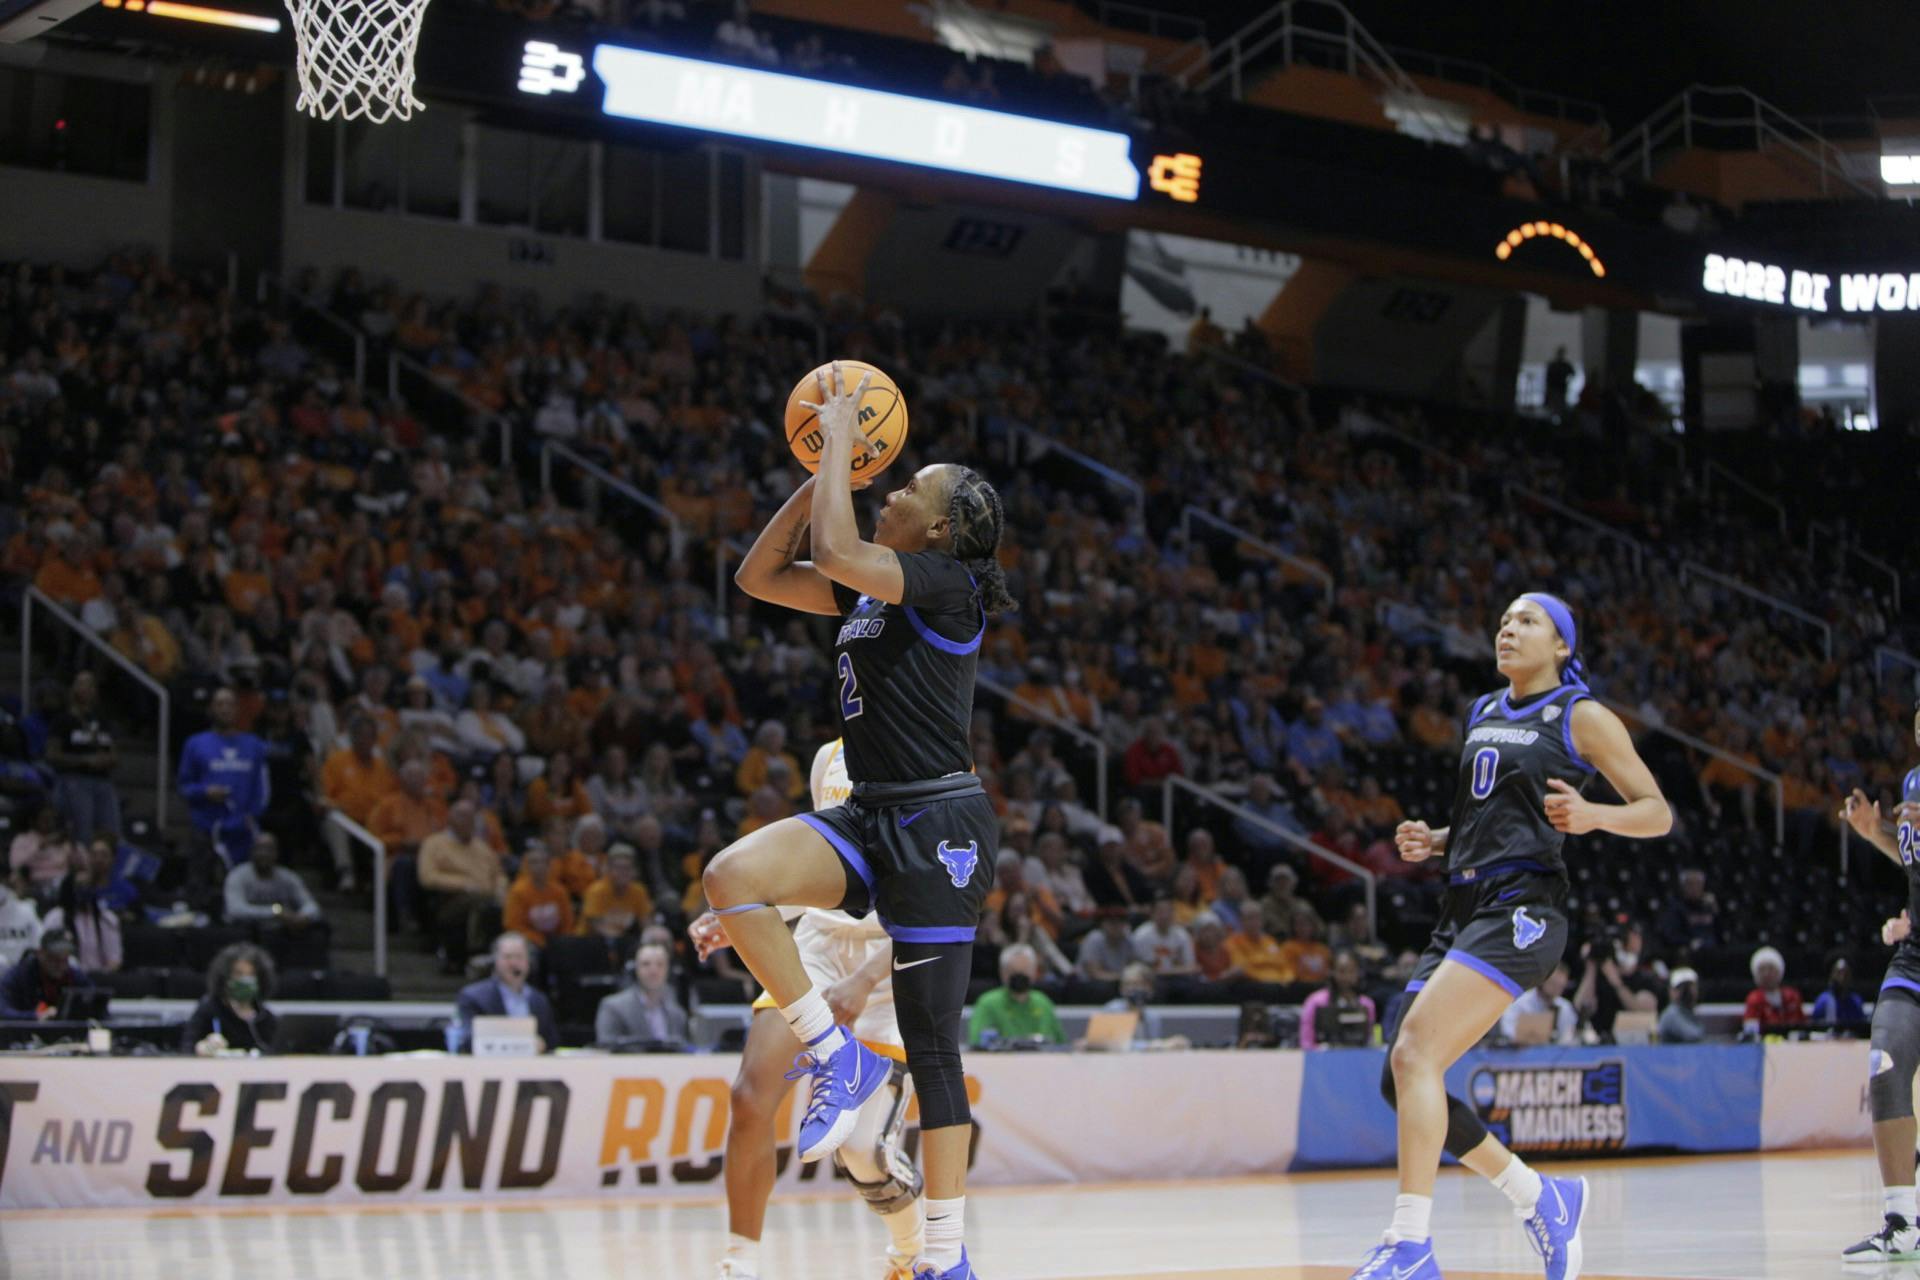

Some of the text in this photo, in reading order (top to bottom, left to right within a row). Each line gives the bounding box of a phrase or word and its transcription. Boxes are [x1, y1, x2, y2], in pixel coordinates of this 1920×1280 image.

[1703, 253, 1787, 304] 2022
[838, 651, 863, 721] 2
[1472, 747, 1500, 800] 0
[1494, 1069, 1584, 1109] MARCH
[31, 1118, 133, 1165] AND
[144, 1079, 571, 1199] SECOND
[1510, 1104, 1625, 1144] MADNESS
